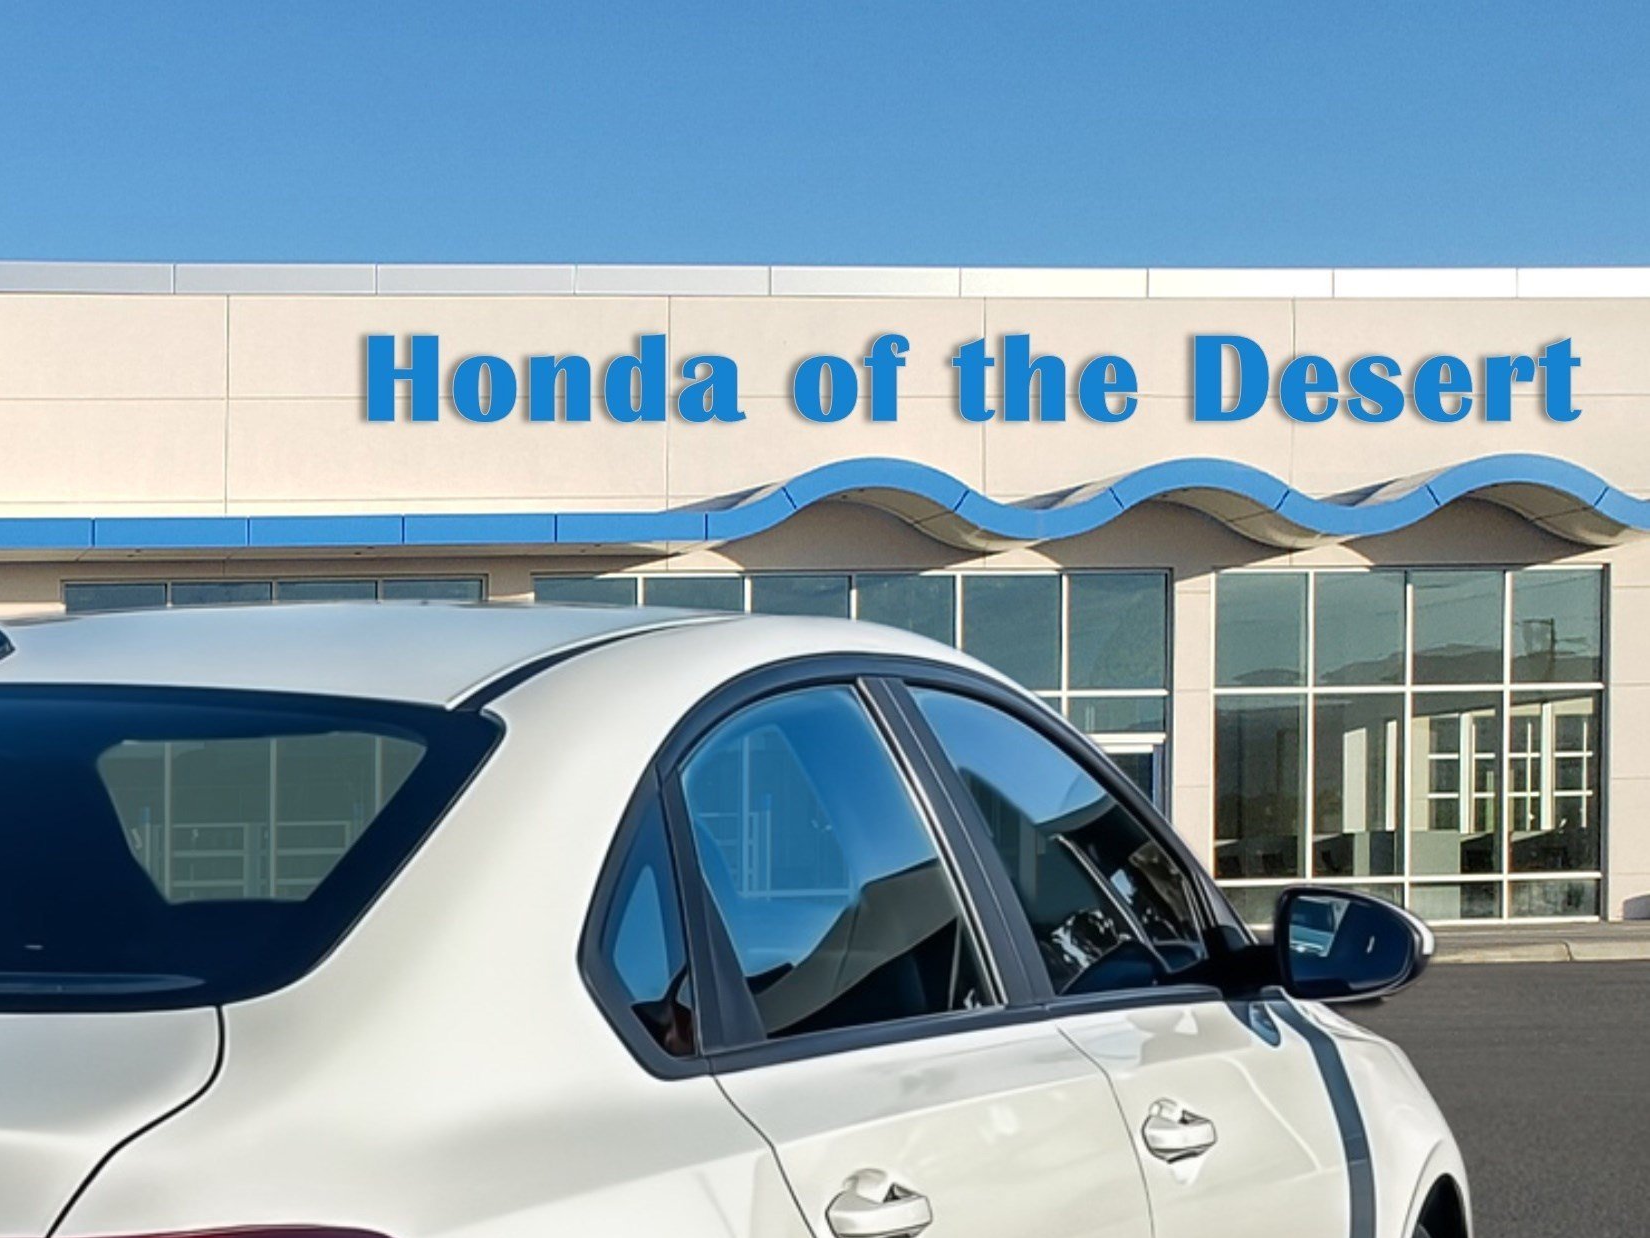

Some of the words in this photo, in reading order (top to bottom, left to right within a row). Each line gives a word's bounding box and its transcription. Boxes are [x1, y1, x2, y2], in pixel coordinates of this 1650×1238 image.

[366, 334, 746, 423] Honda
[793, 333, 910, 423] of
[952, 334, 1139, 423] the
[1193, 334, 1582, 423] Desert
